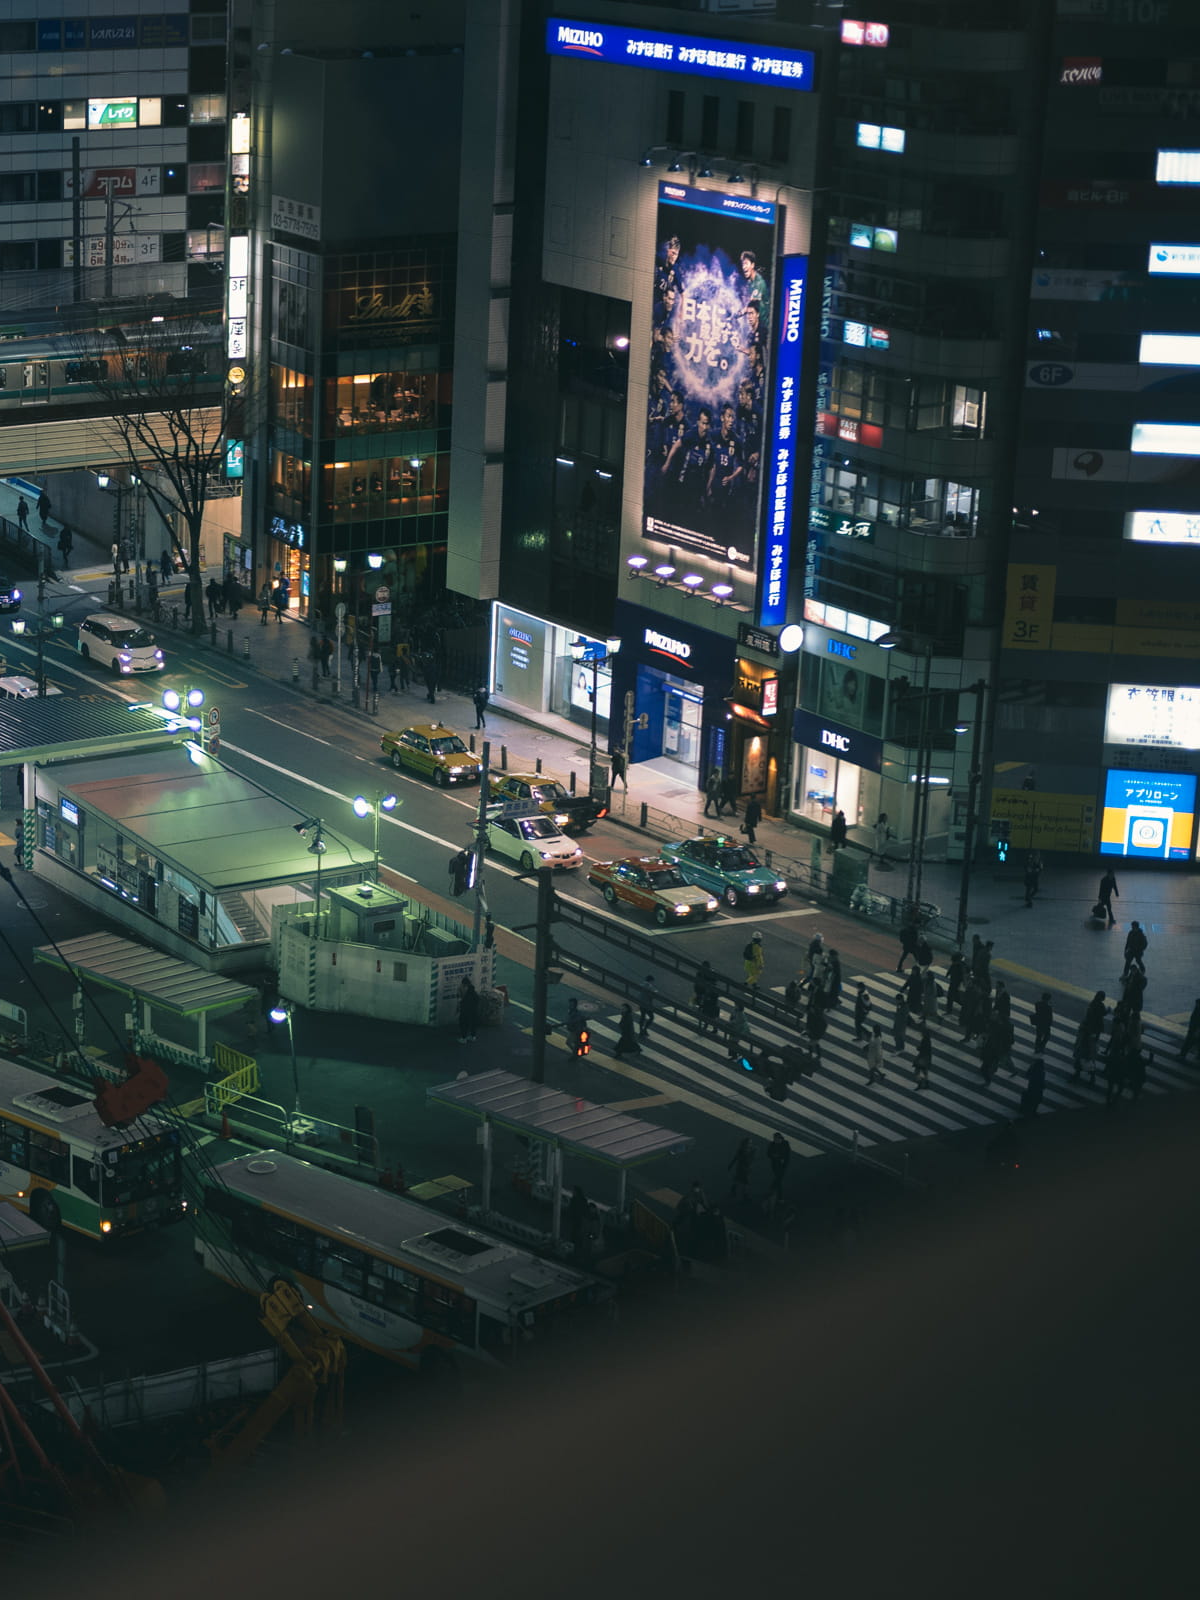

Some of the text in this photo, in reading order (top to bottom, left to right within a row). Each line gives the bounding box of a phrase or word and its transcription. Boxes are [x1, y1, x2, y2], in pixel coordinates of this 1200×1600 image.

[558, 26, 604, 47] MIZUHO
[626, 39, 804, 79] みずほ銀行 みずほ信託銀行 みずほ証券
[108, 107, 134, 119] レイク
[141, 174, 158, 187] 4F
[141, 243, 157, 255] 3F
[787, 278, 803, 343] MIZUHO
[779, 376, 794, 440] みずほ証券
[840, 418, 858, 431] FAST
[773, 448, 789, 536] みずほ信託銀行
[768, 545, 783, 606] みずほ銀行
[1013, 620, 1040, 638] 3F
[644, 628, 691, 658] MIZUHO
[827, 638, 857, 660] DHC
[822, 729, 850, 751] DHC
[1125, 788, 1179, 801] アプリローン
